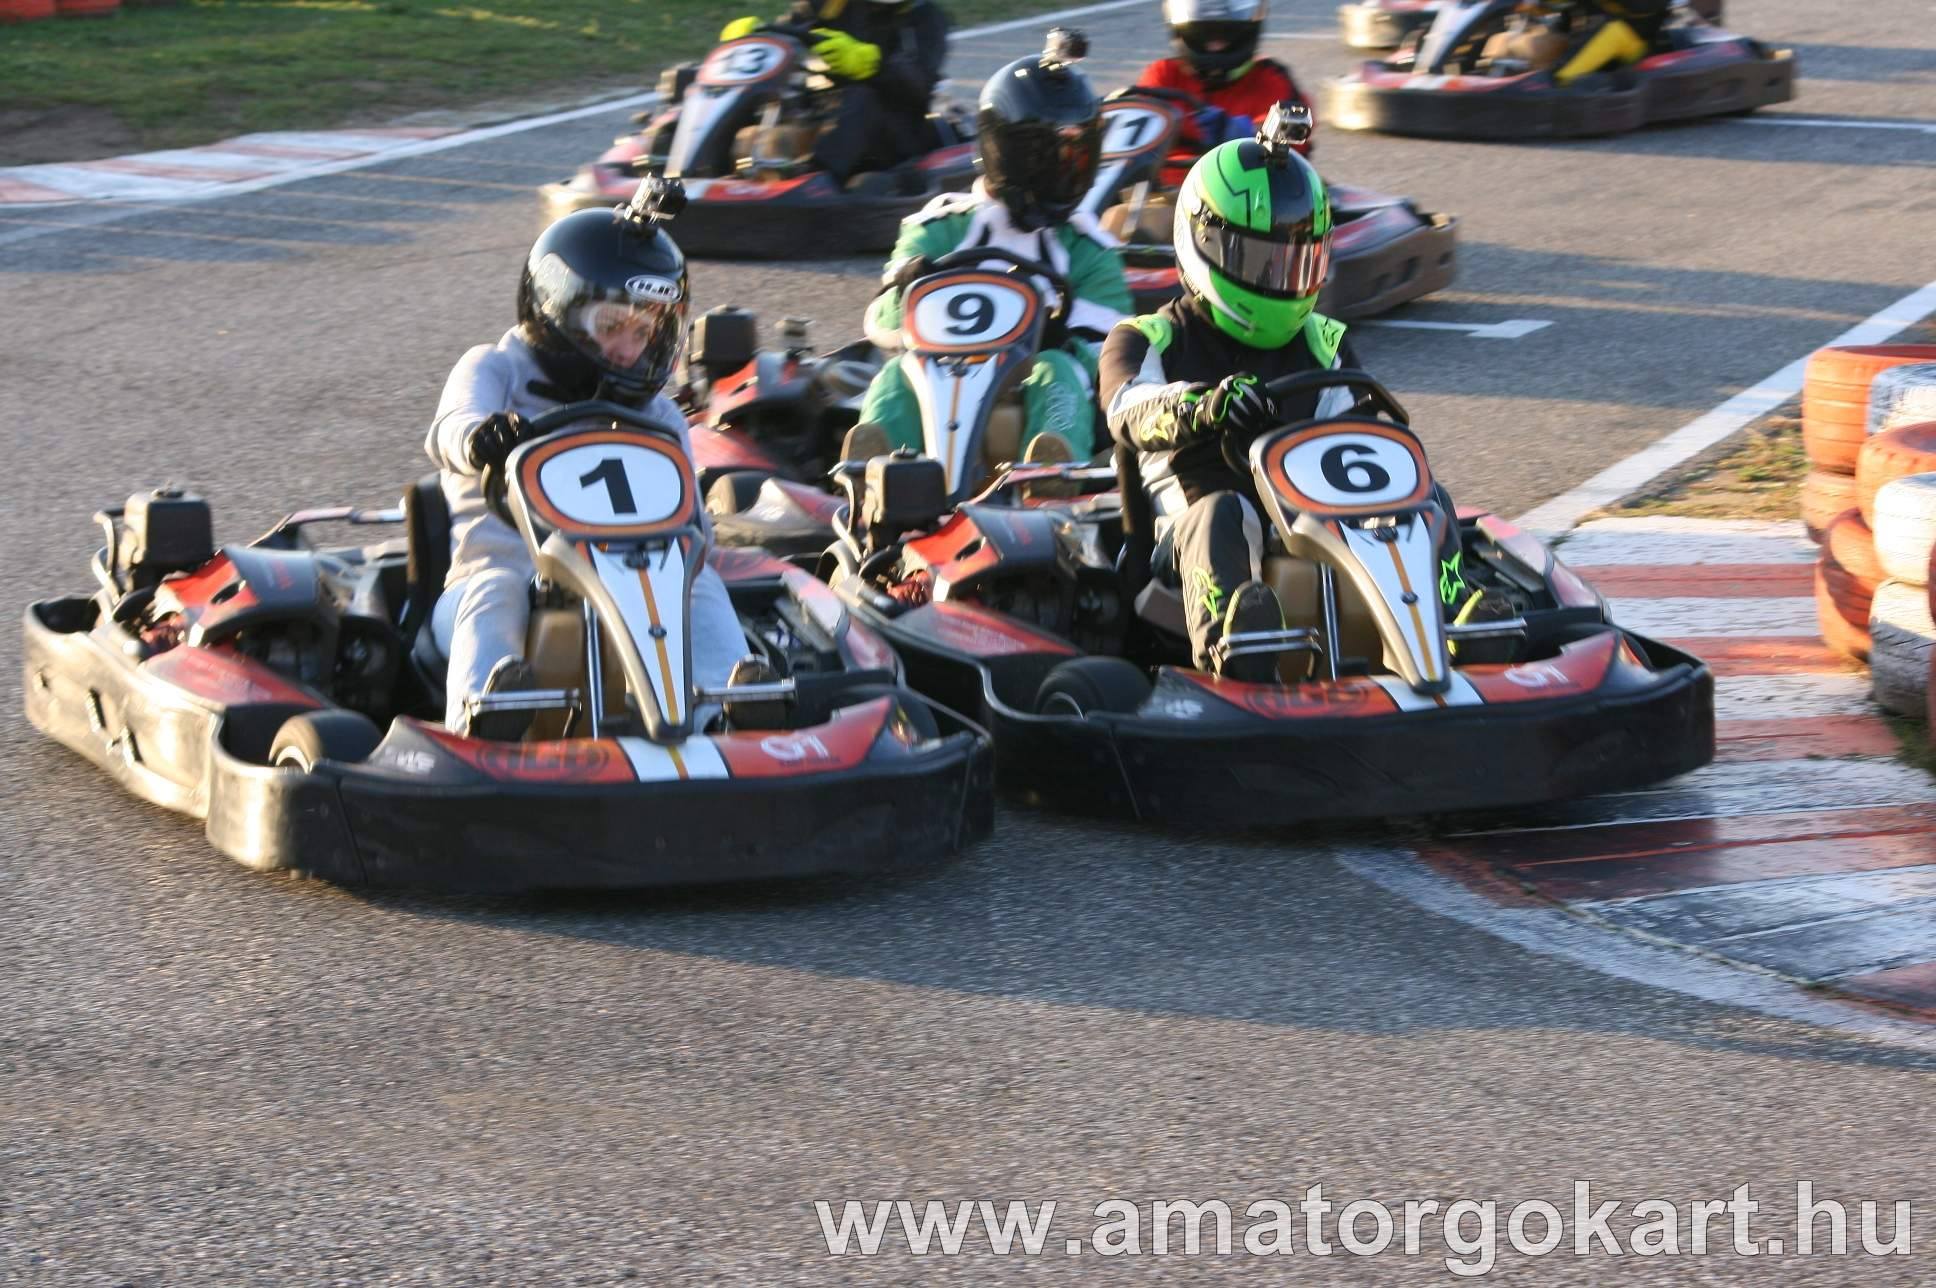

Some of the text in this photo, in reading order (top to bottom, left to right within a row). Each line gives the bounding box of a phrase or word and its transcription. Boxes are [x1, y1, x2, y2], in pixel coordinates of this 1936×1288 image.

[945, 292, 995, 336] 9
[579, 458, 638, 515] 1
[1320, 443, 1391, 493] 6
